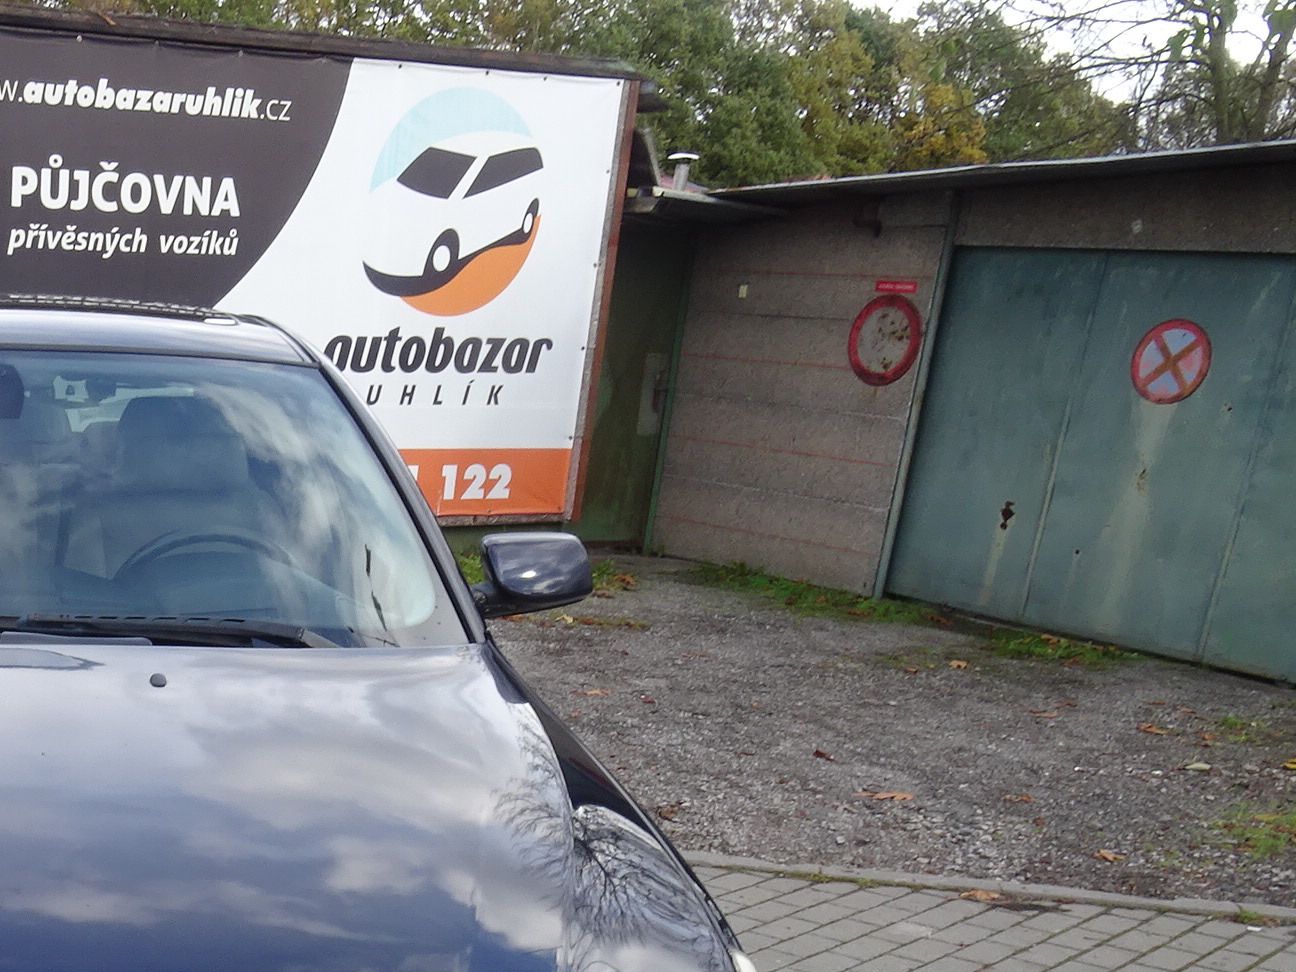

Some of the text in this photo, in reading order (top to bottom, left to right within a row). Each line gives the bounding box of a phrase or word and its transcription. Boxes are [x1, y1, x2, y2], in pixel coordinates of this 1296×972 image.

[11, 154, 241, 217] PŮJČOVNA
[7, 222, 239, 259] přívěsných vozíků
[324, 326, 553, 374] autobazar
[441, 464, 513, 500] 122
